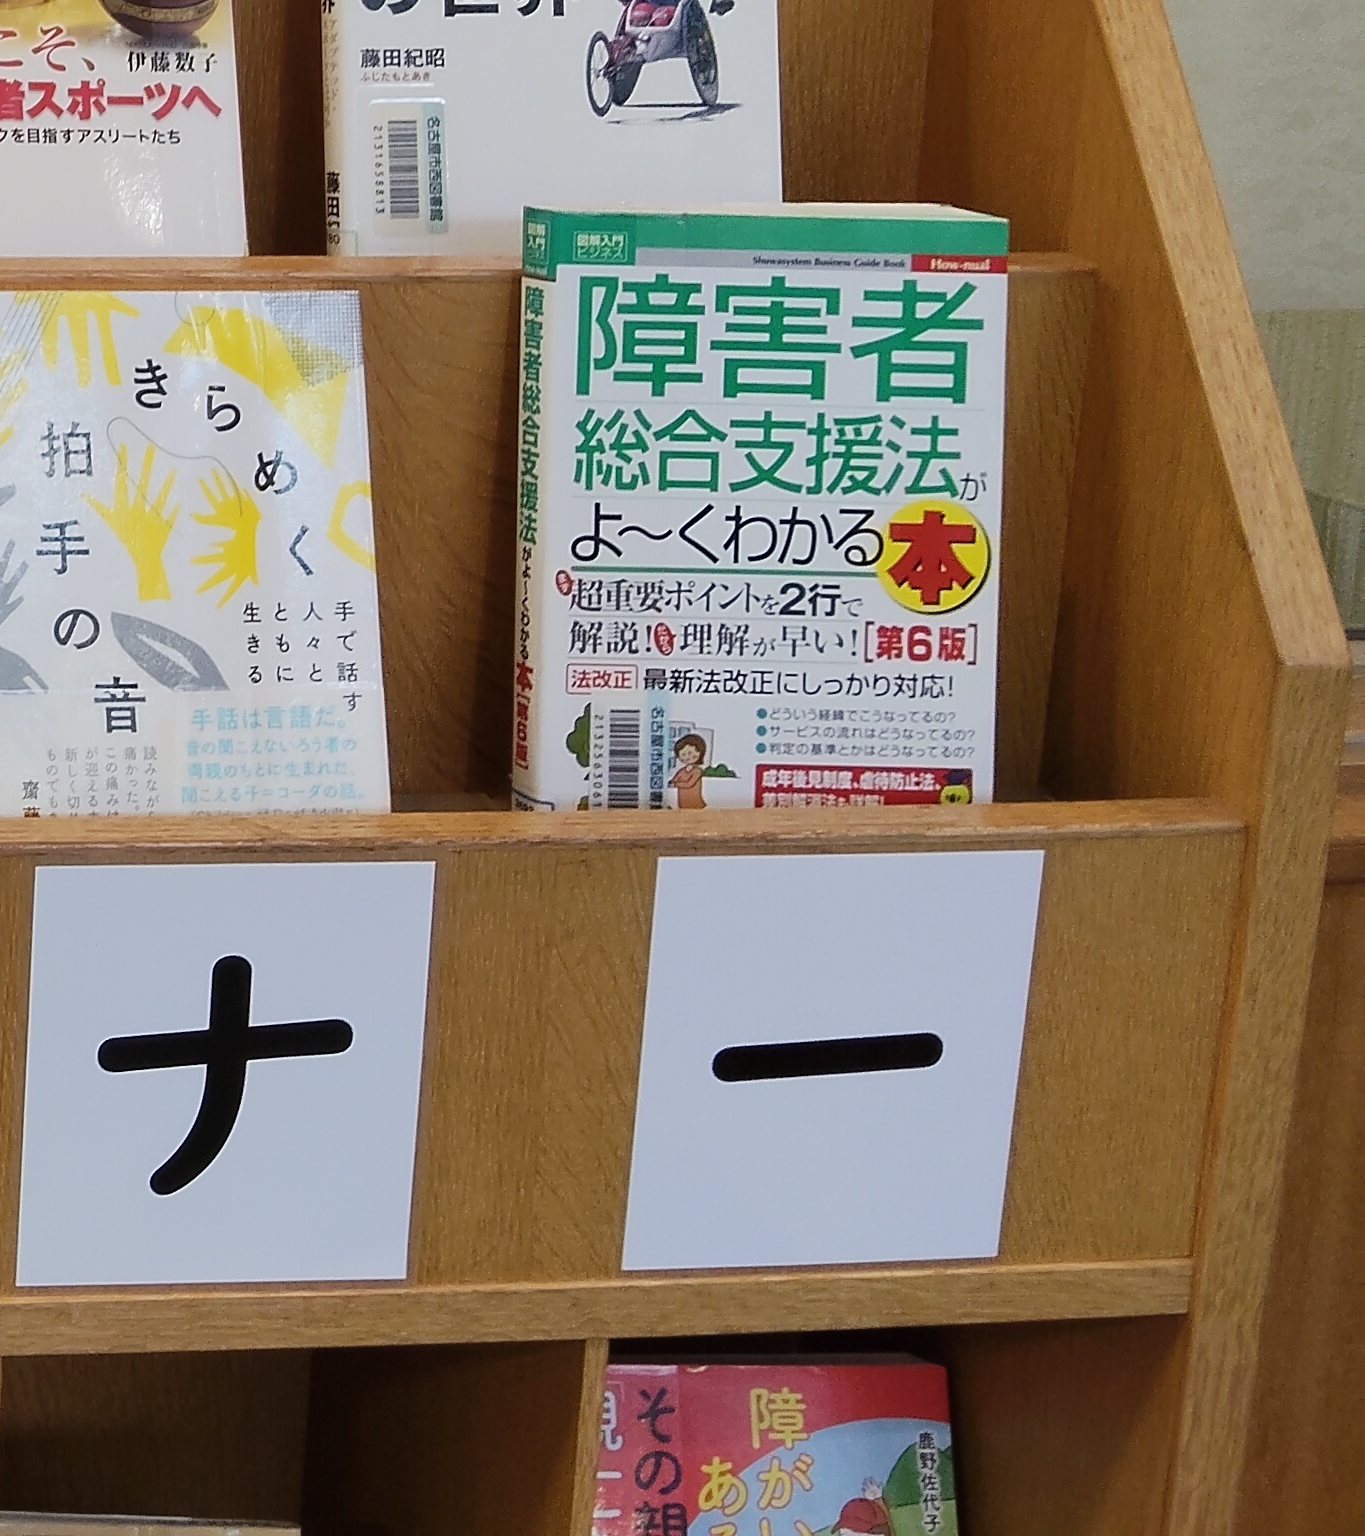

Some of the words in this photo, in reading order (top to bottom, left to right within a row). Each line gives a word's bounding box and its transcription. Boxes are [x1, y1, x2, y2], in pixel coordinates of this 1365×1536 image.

[127, 50, 219, 75] 伊藤数子
[360, 47, 446, 69] 藤田紀昭
[575, 273, 985, 405] 障害者
[133, 359, 314, 577] きらめく
[573, 408, 989, 501] 総合支援法が
[35, 420, 147, 735] 拍手の音
[569, 579, 865, 617] 超重要ポイントを2行で
[242, 601, 264, 685] 生きる
[273, 601, 296, 684] ともに
[303, 600, 325, 684] 人々と
[333, 600, 363, 713] 手で話す
[570, 670, 634, 690] 法改正
[191, 703, 347, 732] 手話は言語だ。
[917, 1431, 943, 1534] 鹿野佐代子
